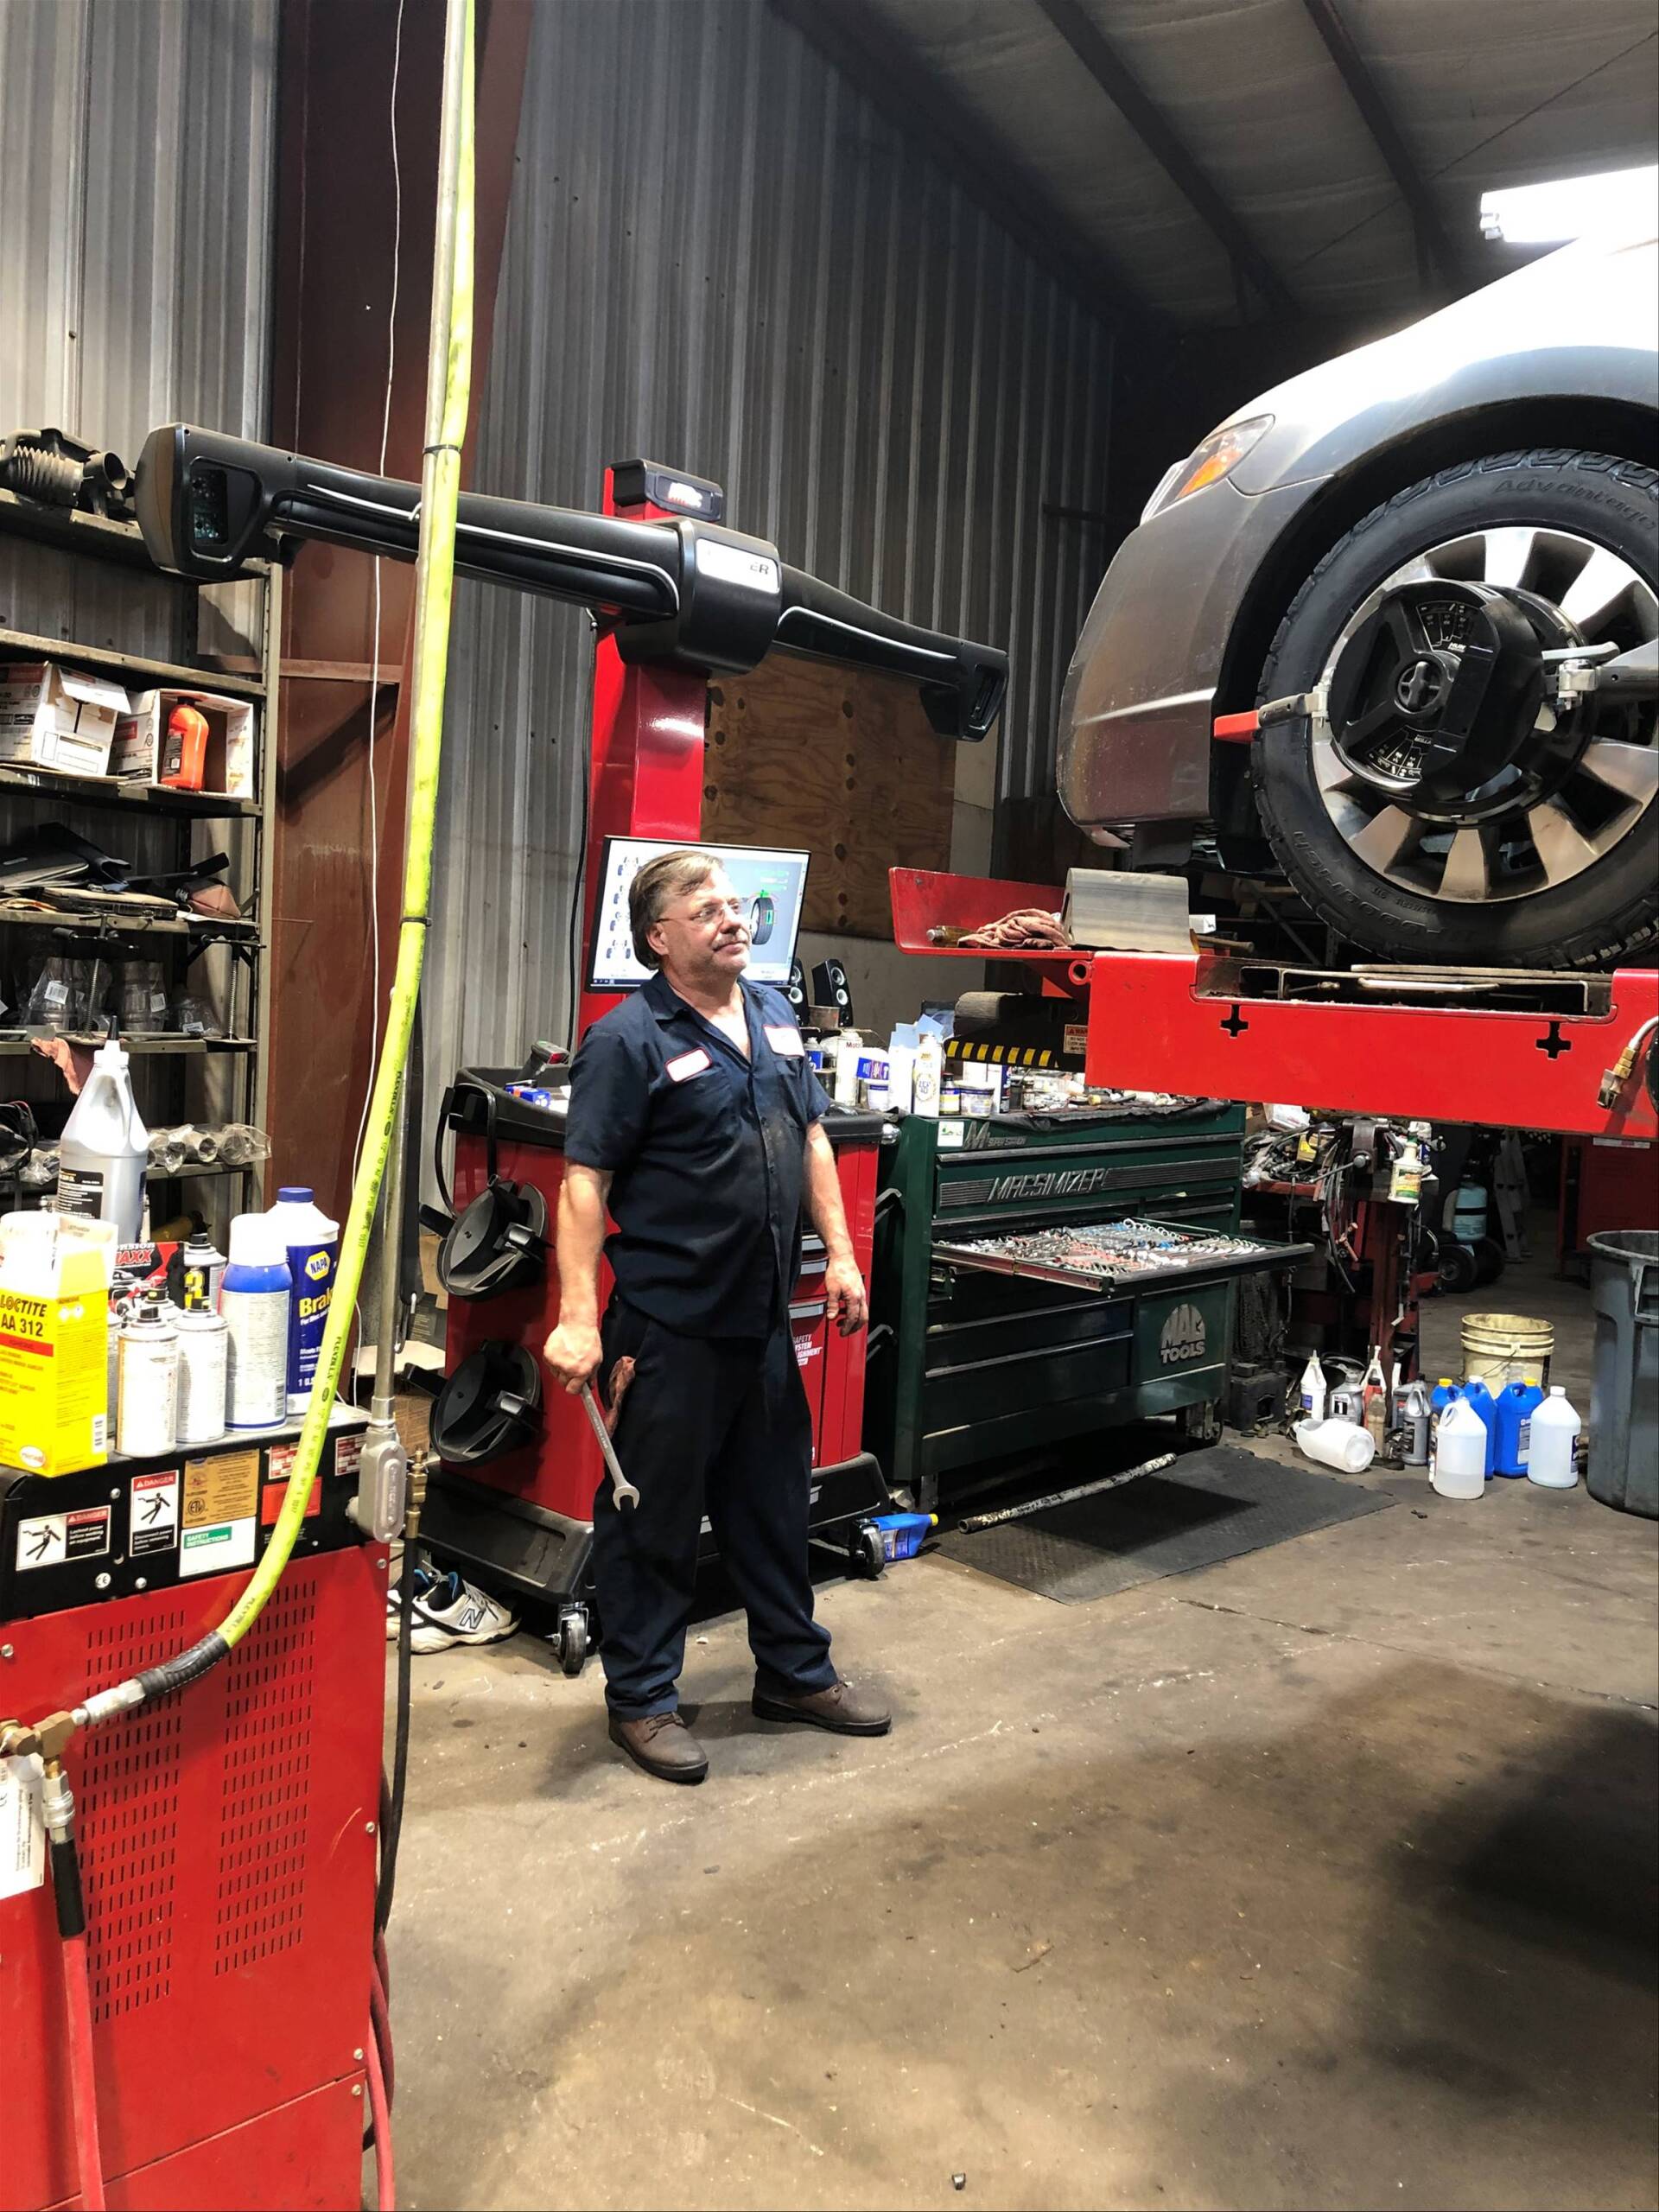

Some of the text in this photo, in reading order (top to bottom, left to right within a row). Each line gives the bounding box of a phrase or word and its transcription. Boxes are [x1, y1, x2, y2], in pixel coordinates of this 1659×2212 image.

[309, 1256, 328, 1275] NAPA
[0, 1295, 48, 1318] LOCTITE
[299, 1287, 334, 1319] Brak
[1, 1313, 44, 1338] AA 312
[1160, 1303, 1206, 1349] MAC
[1160, 1341, 1206, 1363] TOOLS
[143, 1477, 173, 1487] DANGER
[76, 1510, 107, 1521] DANGER
[186, 1533, 208, 1542] SAFETY
